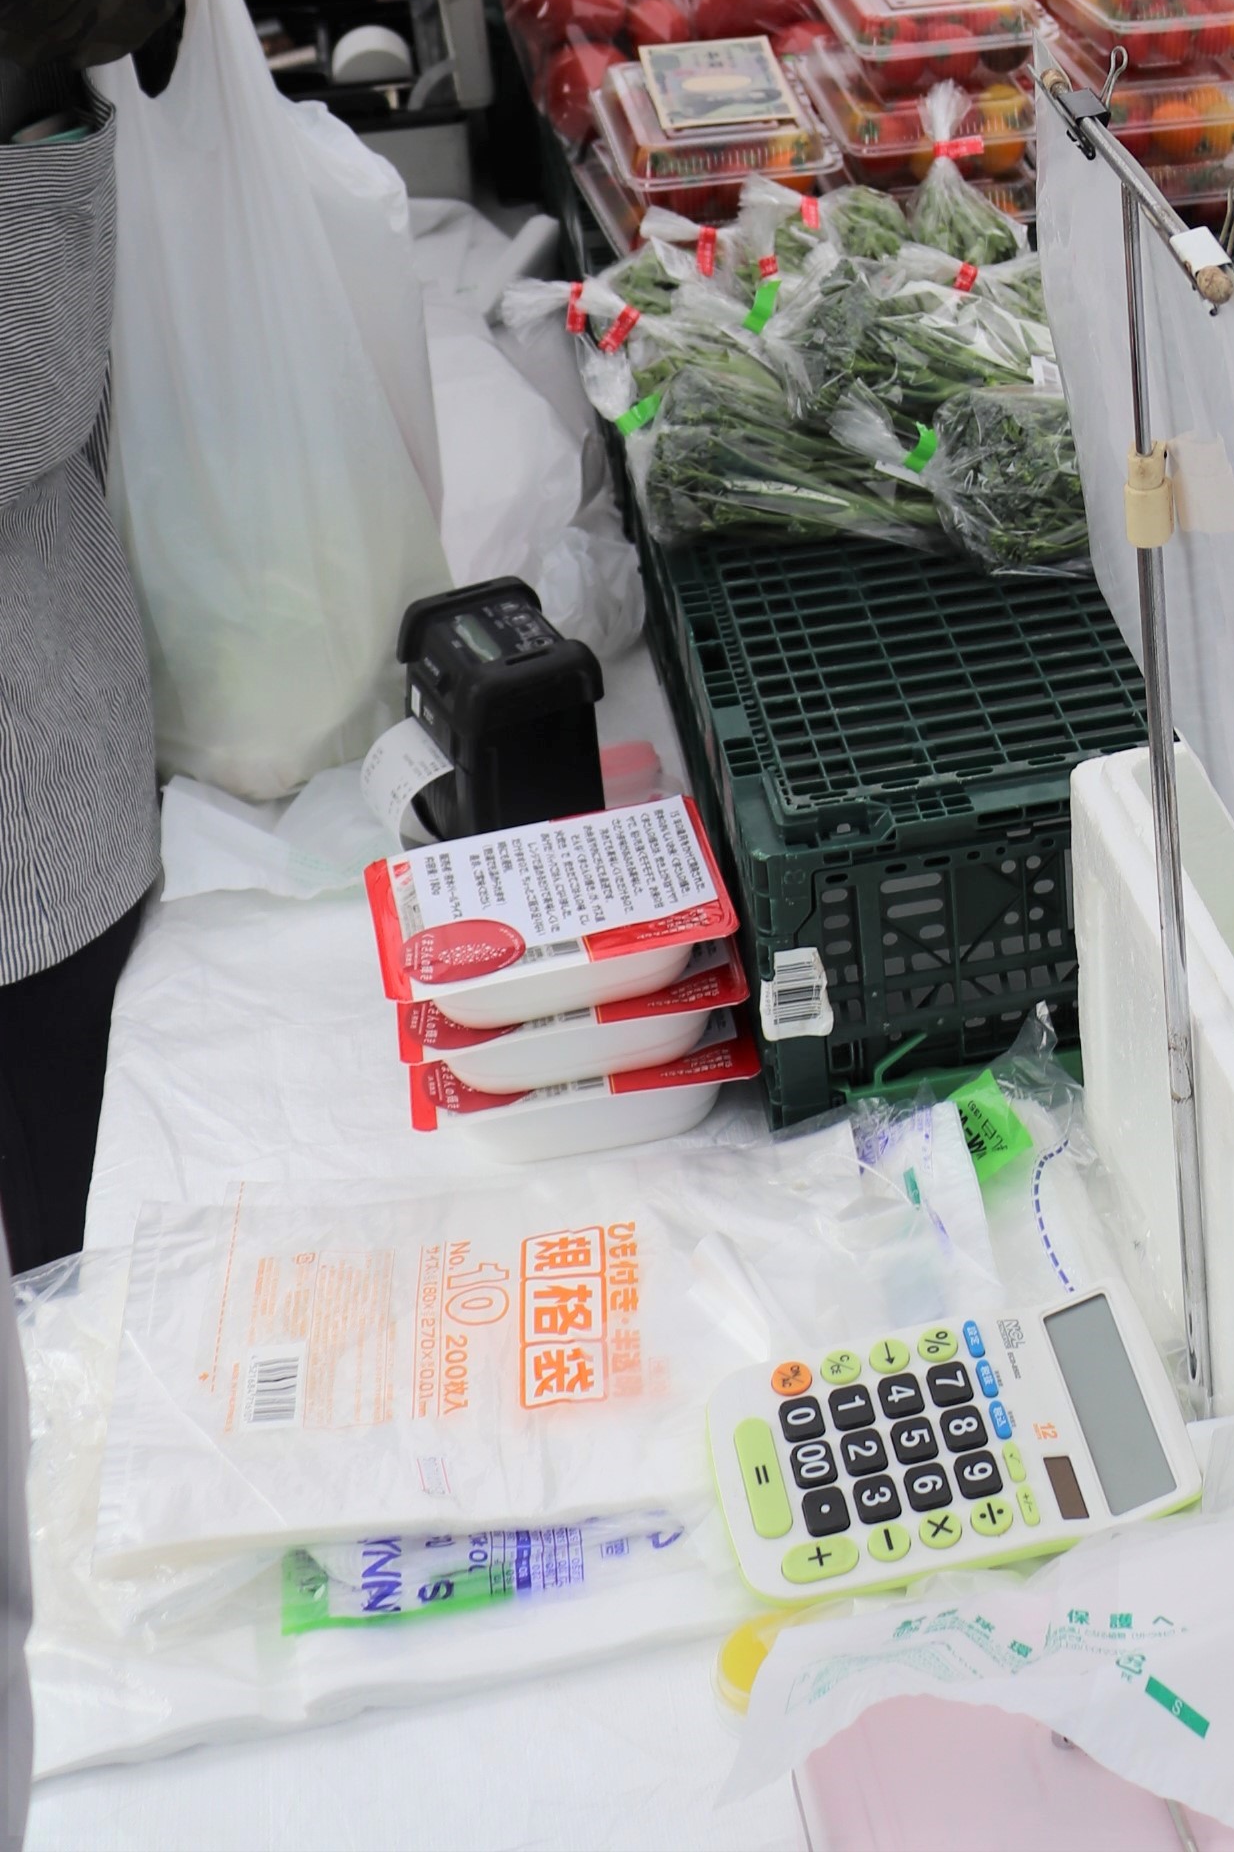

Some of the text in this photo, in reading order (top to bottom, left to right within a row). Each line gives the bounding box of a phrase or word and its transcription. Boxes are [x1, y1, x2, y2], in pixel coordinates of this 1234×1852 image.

[533, 1236, 594, 1396] 規格袋
[443, 1334, 469, 1415] 200枚入
[934, 1371, 965, 1388] 7
[836, 1397, 866, 1412] 1
[886, 1386, 916, 1404] 4
[786, 1406, 816, 1426] 0
[949, 1417, 978, 1436] 8
[1040, 1422, 1058, 1439] 12
[900, 1429, 932, 1448] 5
[848, 1442, 878, 1461] 2
[796, 1444, 830, 1479] 00
[963, 1462, 993, 1481] 9
[912, 1475, 943, 1495] 6
[861, 1488, 892, 1507] 3
[1171, 1699, 1183, 1716] S
